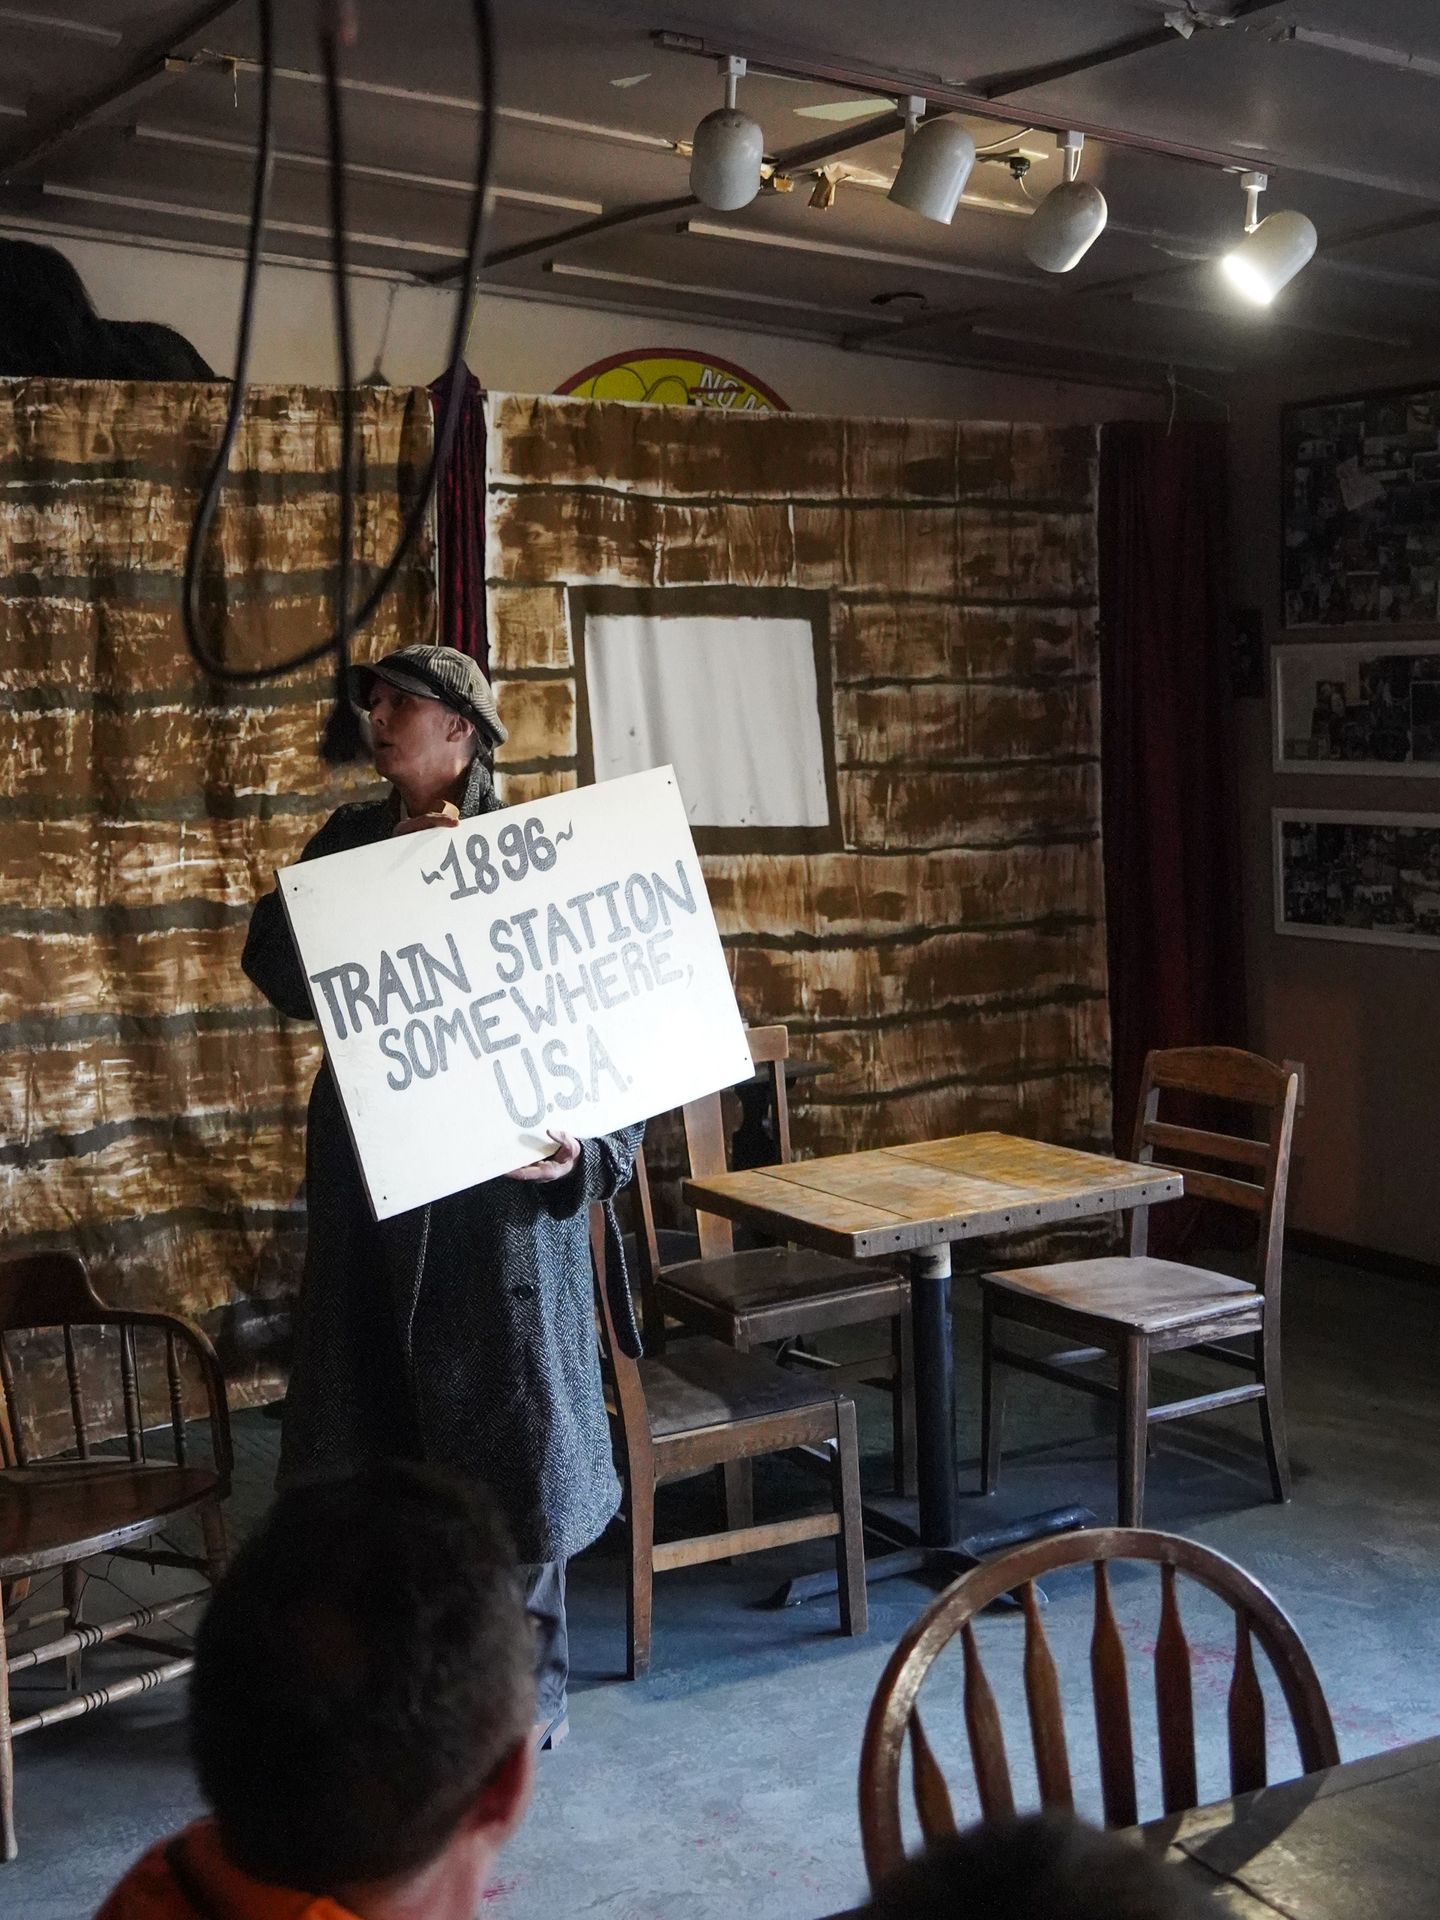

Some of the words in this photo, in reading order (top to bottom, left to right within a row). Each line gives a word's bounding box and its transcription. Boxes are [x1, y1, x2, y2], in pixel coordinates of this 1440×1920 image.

[700, 368, 739, 409] NO
[310, 933, 471, 1040] TRAIN
[489, 860, 697, 984] STATION
[378, 930, 694, 1091] SOMEWHERE,
[493, 1025, 634, 1128] U.S.A.
